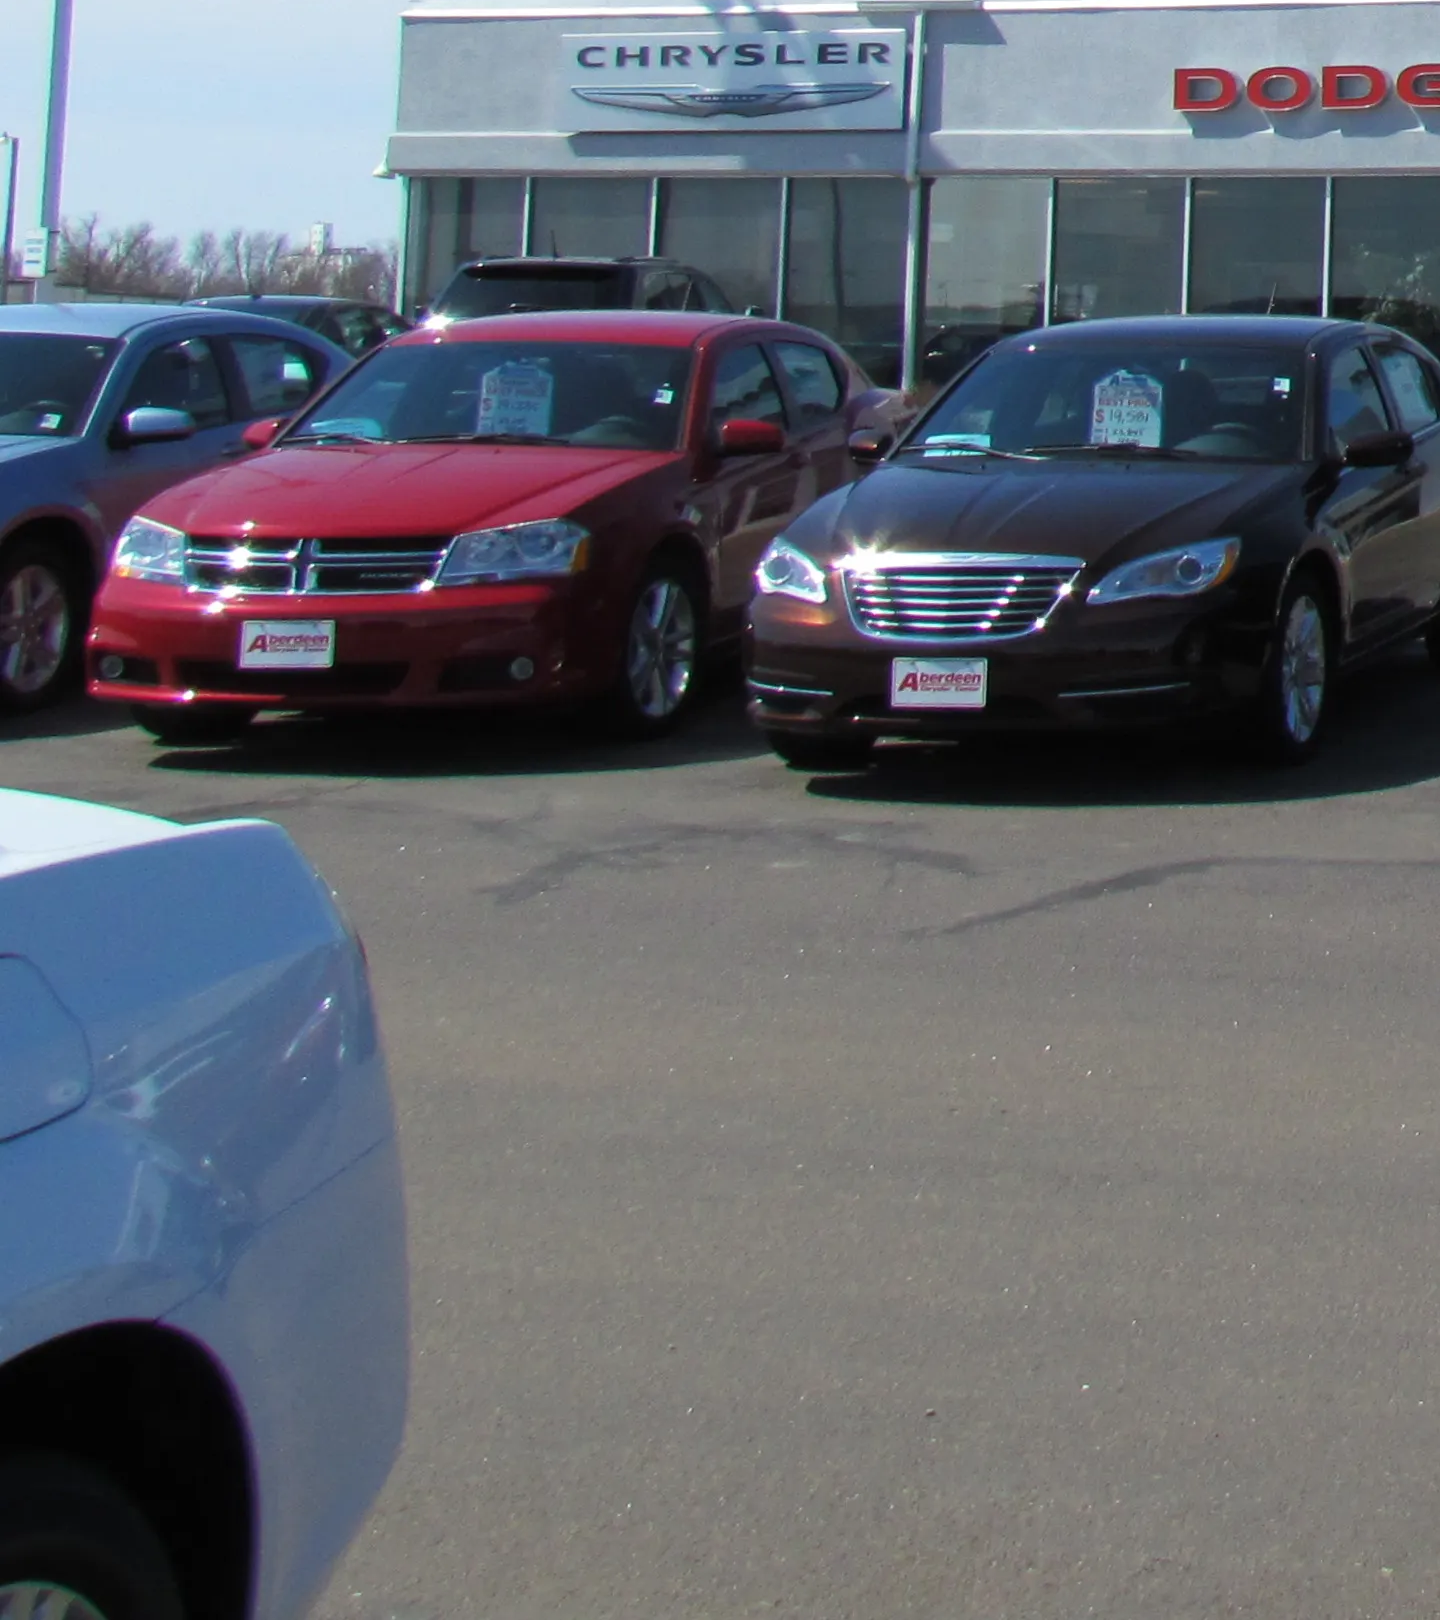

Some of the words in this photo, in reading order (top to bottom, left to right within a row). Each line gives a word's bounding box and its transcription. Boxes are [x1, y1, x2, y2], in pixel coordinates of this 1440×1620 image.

[577, 42, 892, 68] CHRYSLER
[247, 634, 329, 653] Aberdeen
[898, 672, 981, 691] Aberdeen
